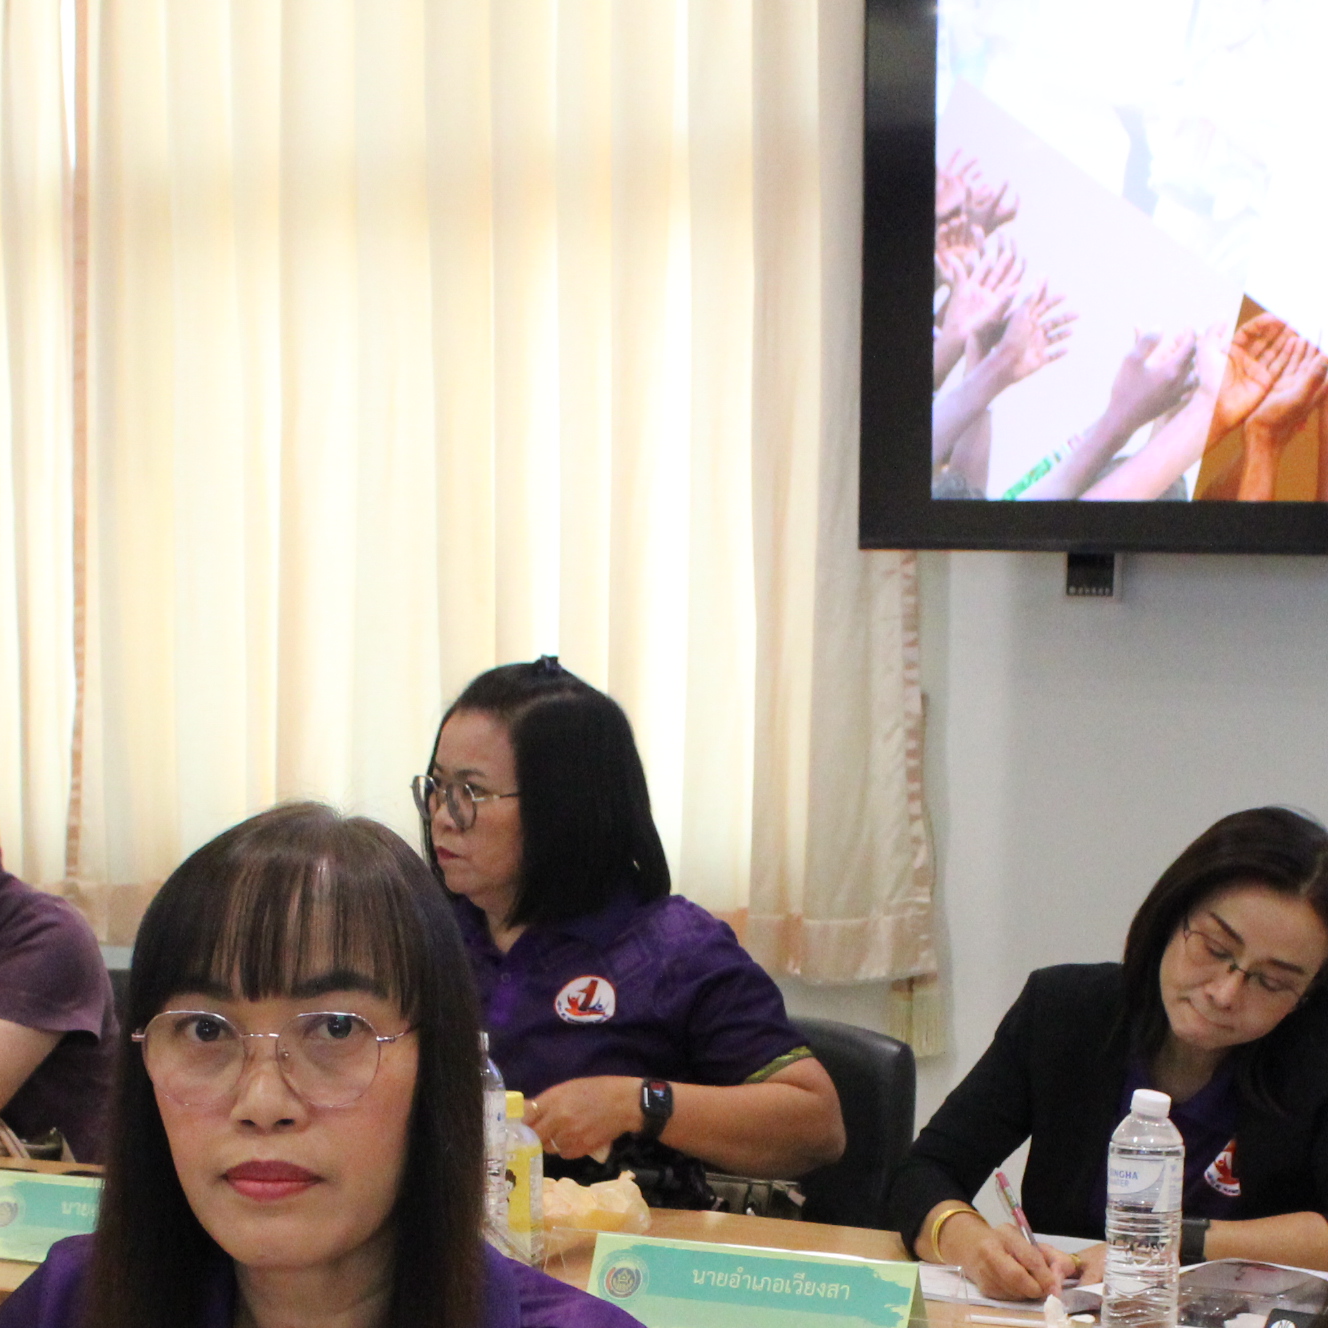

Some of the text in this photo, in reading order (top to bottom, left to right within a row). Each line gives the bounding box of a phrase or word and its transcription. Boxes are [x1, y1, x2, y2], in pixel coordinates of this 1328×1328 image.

[692, 1266, 850, 1300] นายอำเภอเวียงสา
